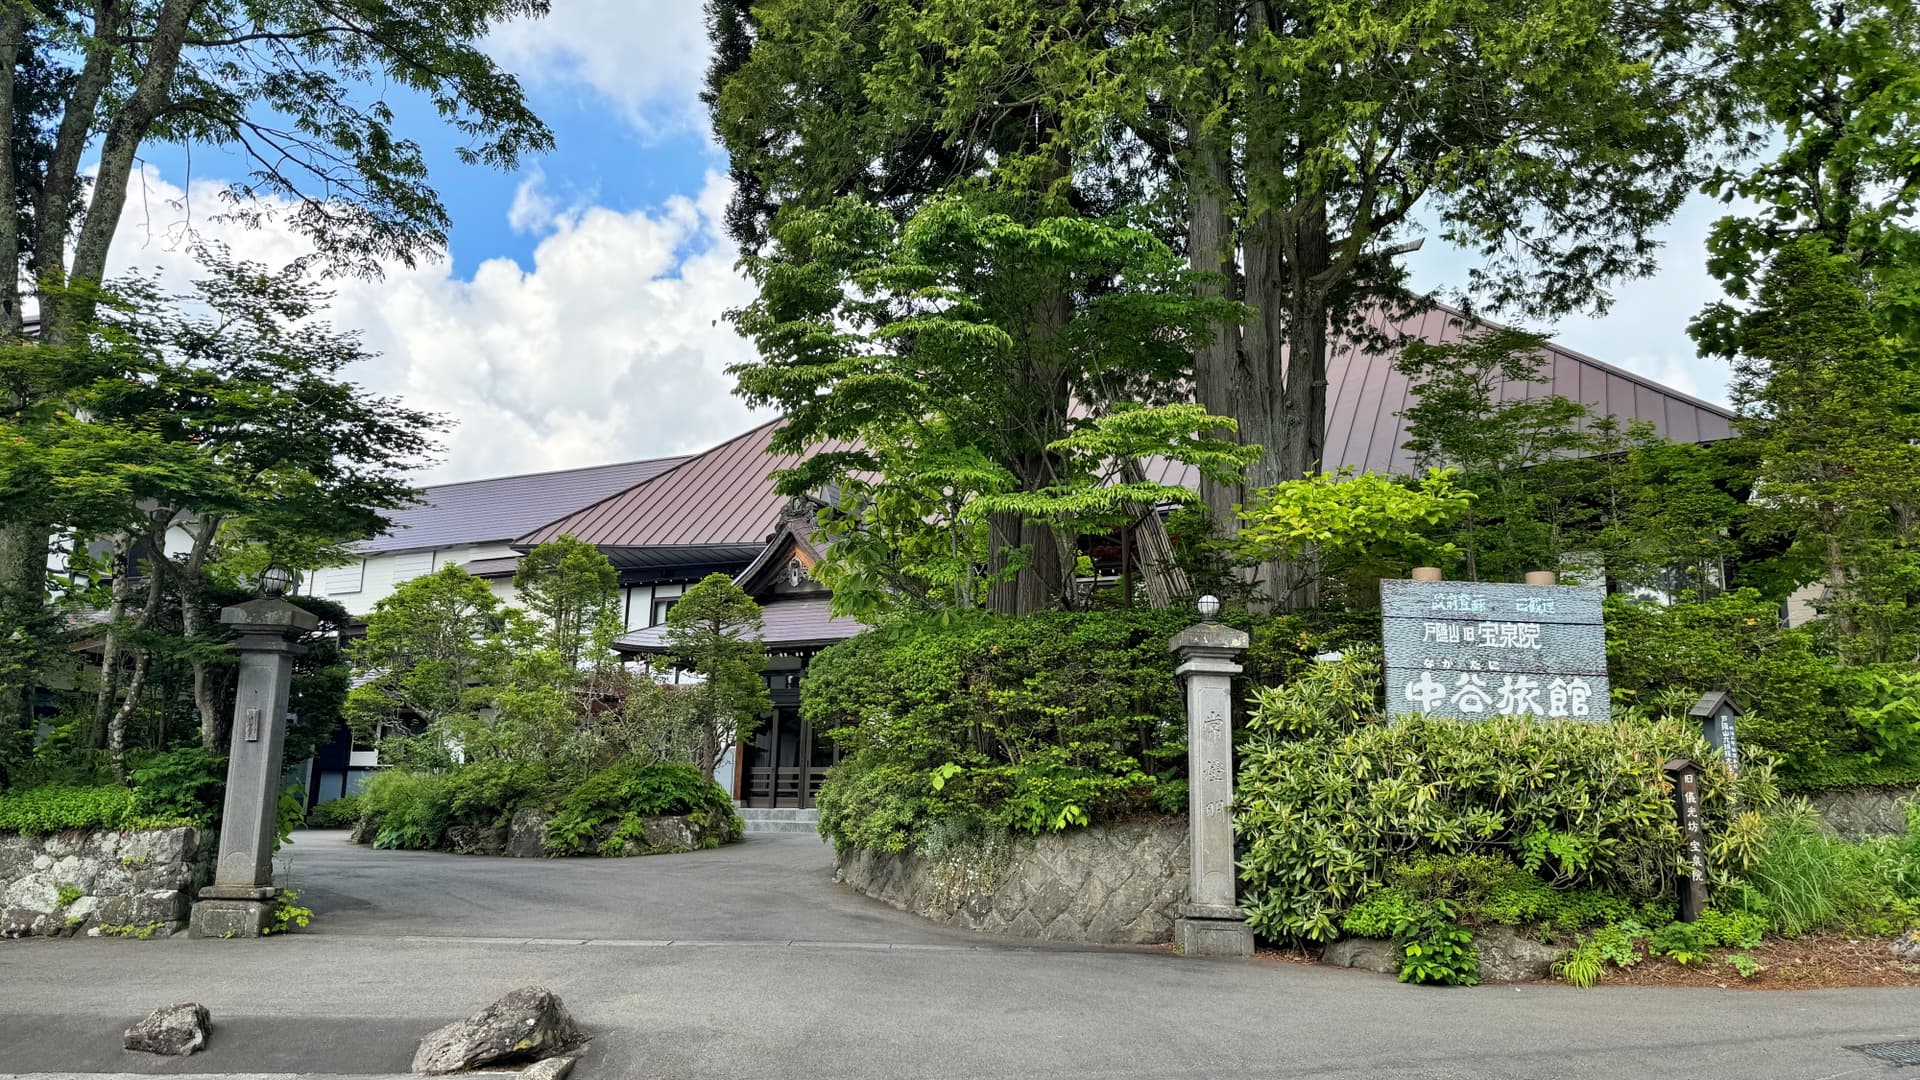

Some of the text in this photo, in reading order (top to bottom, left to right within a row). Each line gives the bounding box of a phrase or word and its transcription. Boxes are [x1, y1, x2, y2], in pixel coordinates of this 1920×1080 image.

[1405, 671, 1592, 717] 中谷旅館
[1684, 774, 1694, 784] 旧
